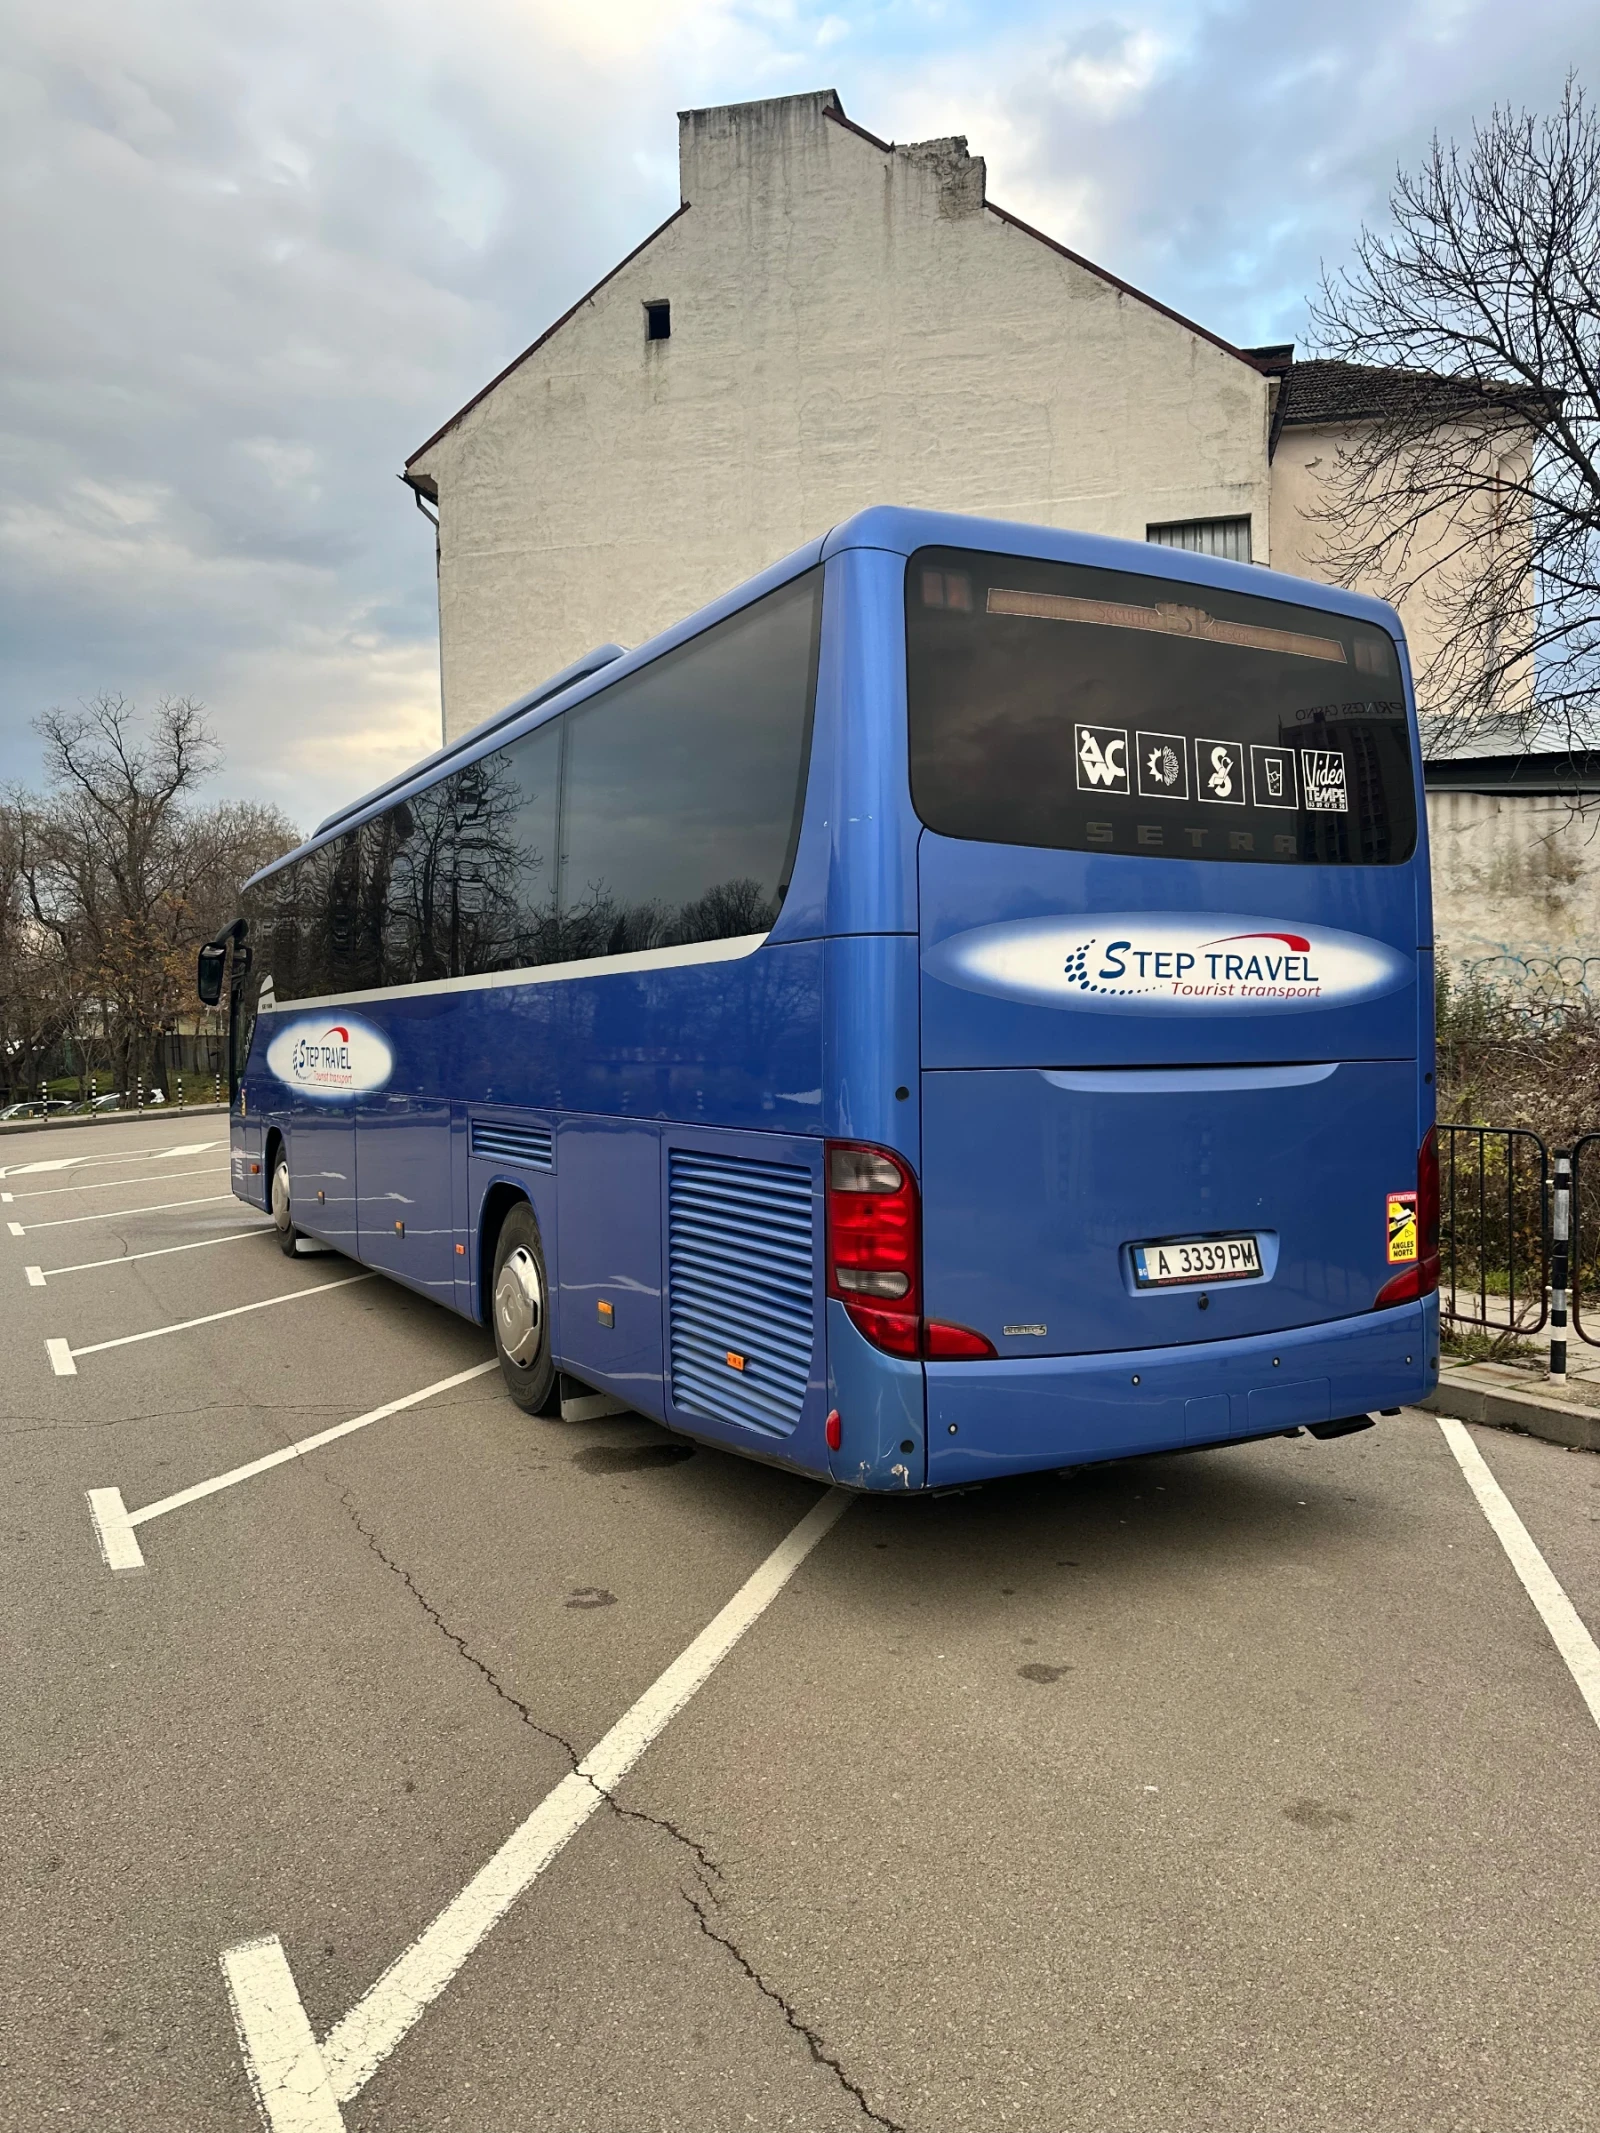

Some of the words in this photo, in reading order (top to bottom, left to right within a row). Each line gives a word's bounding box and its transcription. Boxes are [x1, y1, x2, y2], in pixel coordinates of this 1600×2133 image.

[1305, 752, 1343, 787] Vidéo
[1306, 786, 1345, 803] TEMPE
[1086, 821, 1297, 854] SETRA
[1098, 940, 1195, 979] STEP
[1204, 953, 1319, 982] TRAVEL
[1170, 981, 1235, 997] Tourist
[1240, 984, 1322, 1000] transport
[299, 1039, 320, 1068] STEP
[321, 1047, 352, 1070] TRAVEL
[313, 1070, 329, 1081] Tourist
[329, 1072, 353, 1085] transport
[1392, 1241, 1414, 1250] ANGLES
[1138, 1268, 1147, 1276] BG
[1158, 1250, 1171, 1275] A
[1179, 1245, 1226, 1273] 3339
